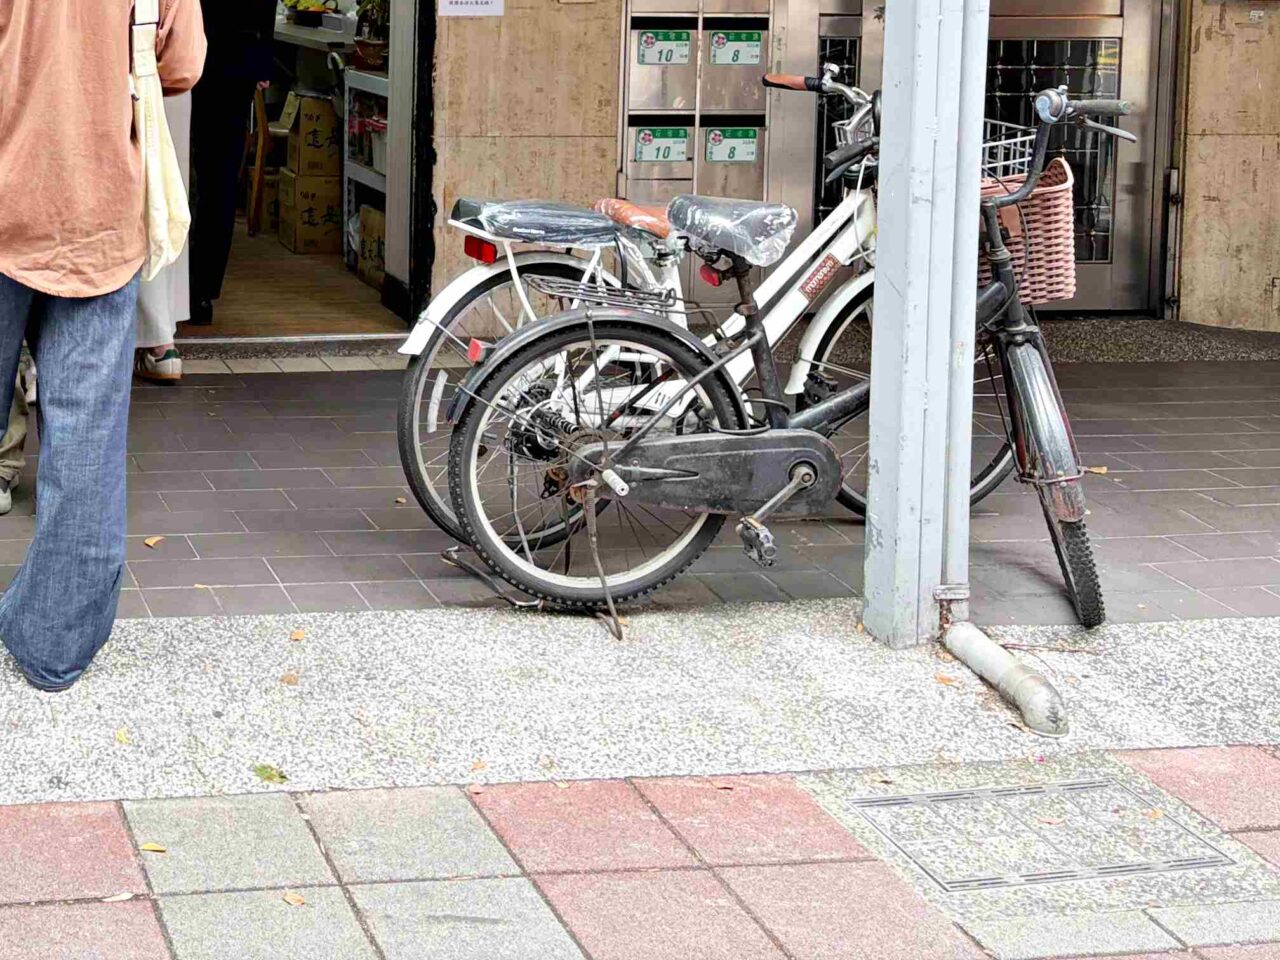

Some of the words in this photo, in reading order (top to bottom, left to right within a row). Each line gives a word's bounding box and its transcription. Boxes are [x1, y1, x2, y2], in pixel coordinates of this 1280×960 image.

[657, 48, 674, 62] 10
[731, 49, 740, 62] 8
[655, 146, 671, 159] 10
[727, 146, 736, 159] 8
